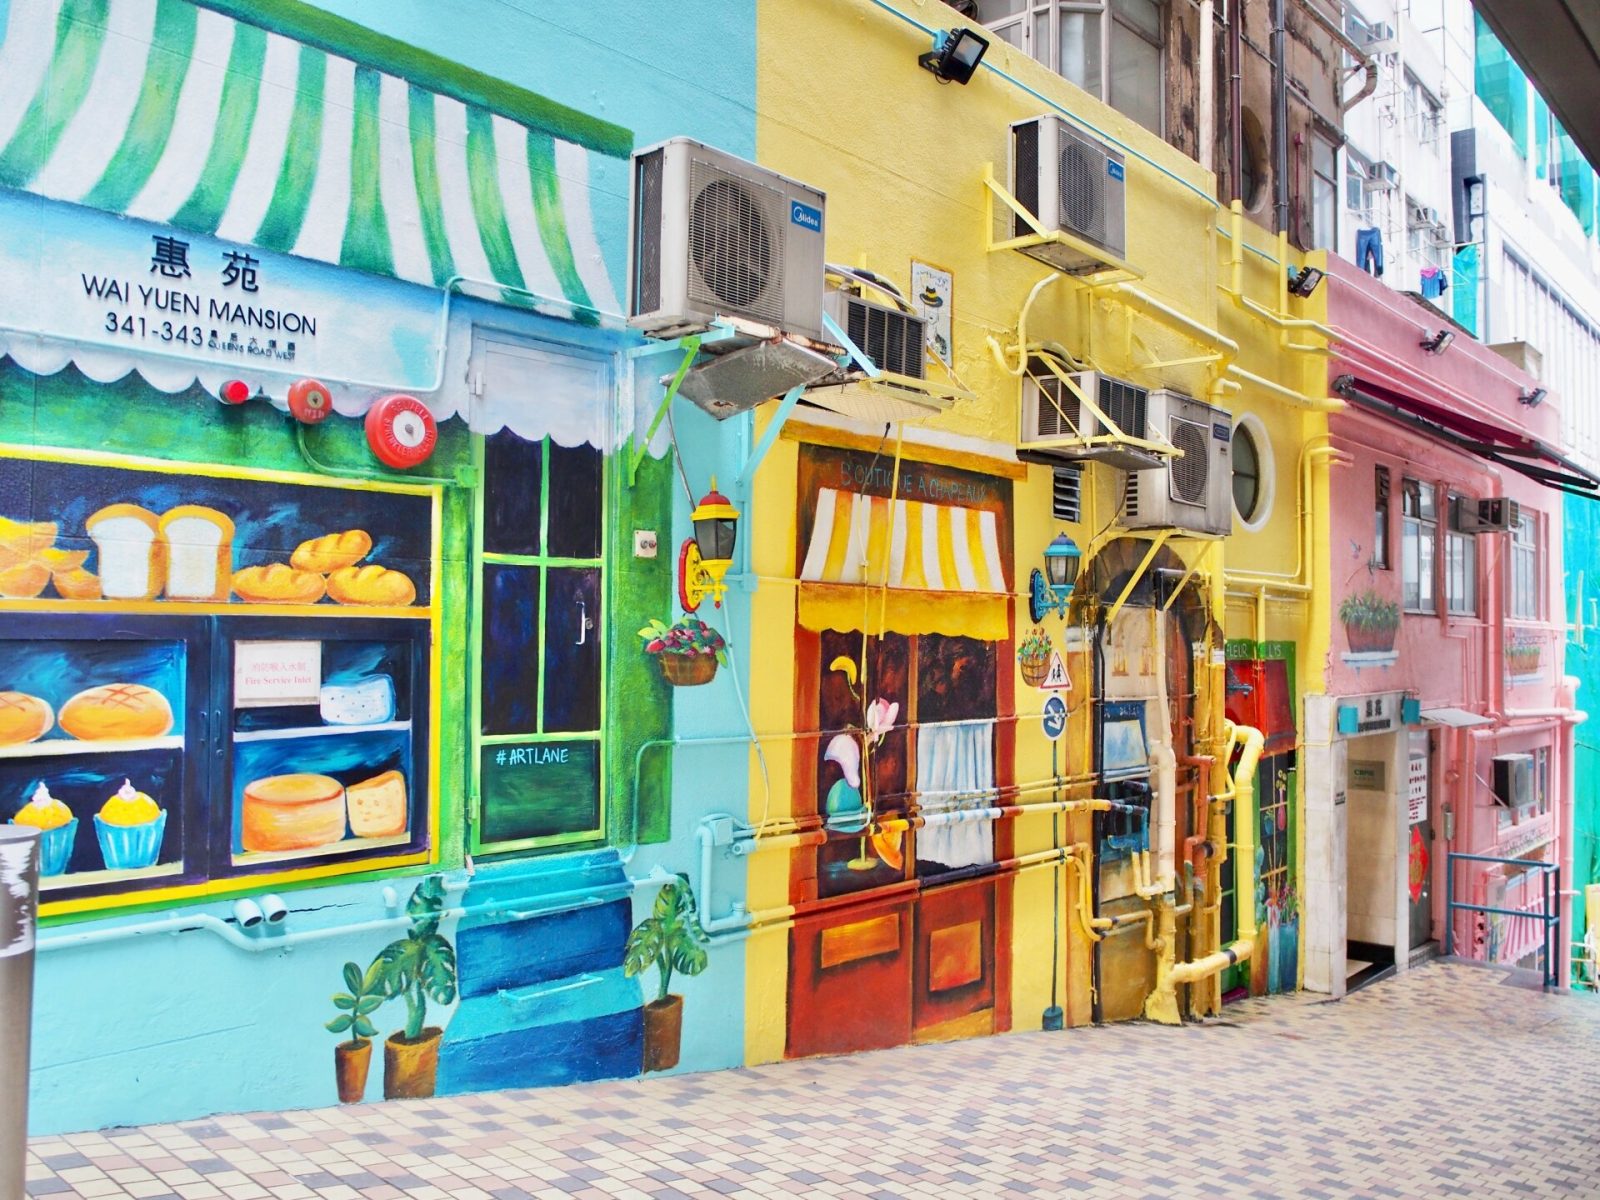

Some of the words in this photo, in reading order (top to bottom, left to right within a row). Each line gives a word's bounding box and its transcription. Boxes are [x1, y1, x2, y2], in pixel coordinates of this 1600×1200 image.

[793, 205, 819, 228] Midea
[82, 273, 129, 305] WAI
[138, 285, 200, 315] YUEN
[209, 299, 316, 336] MANSION
[105, 312, 203, 347] 341-343
